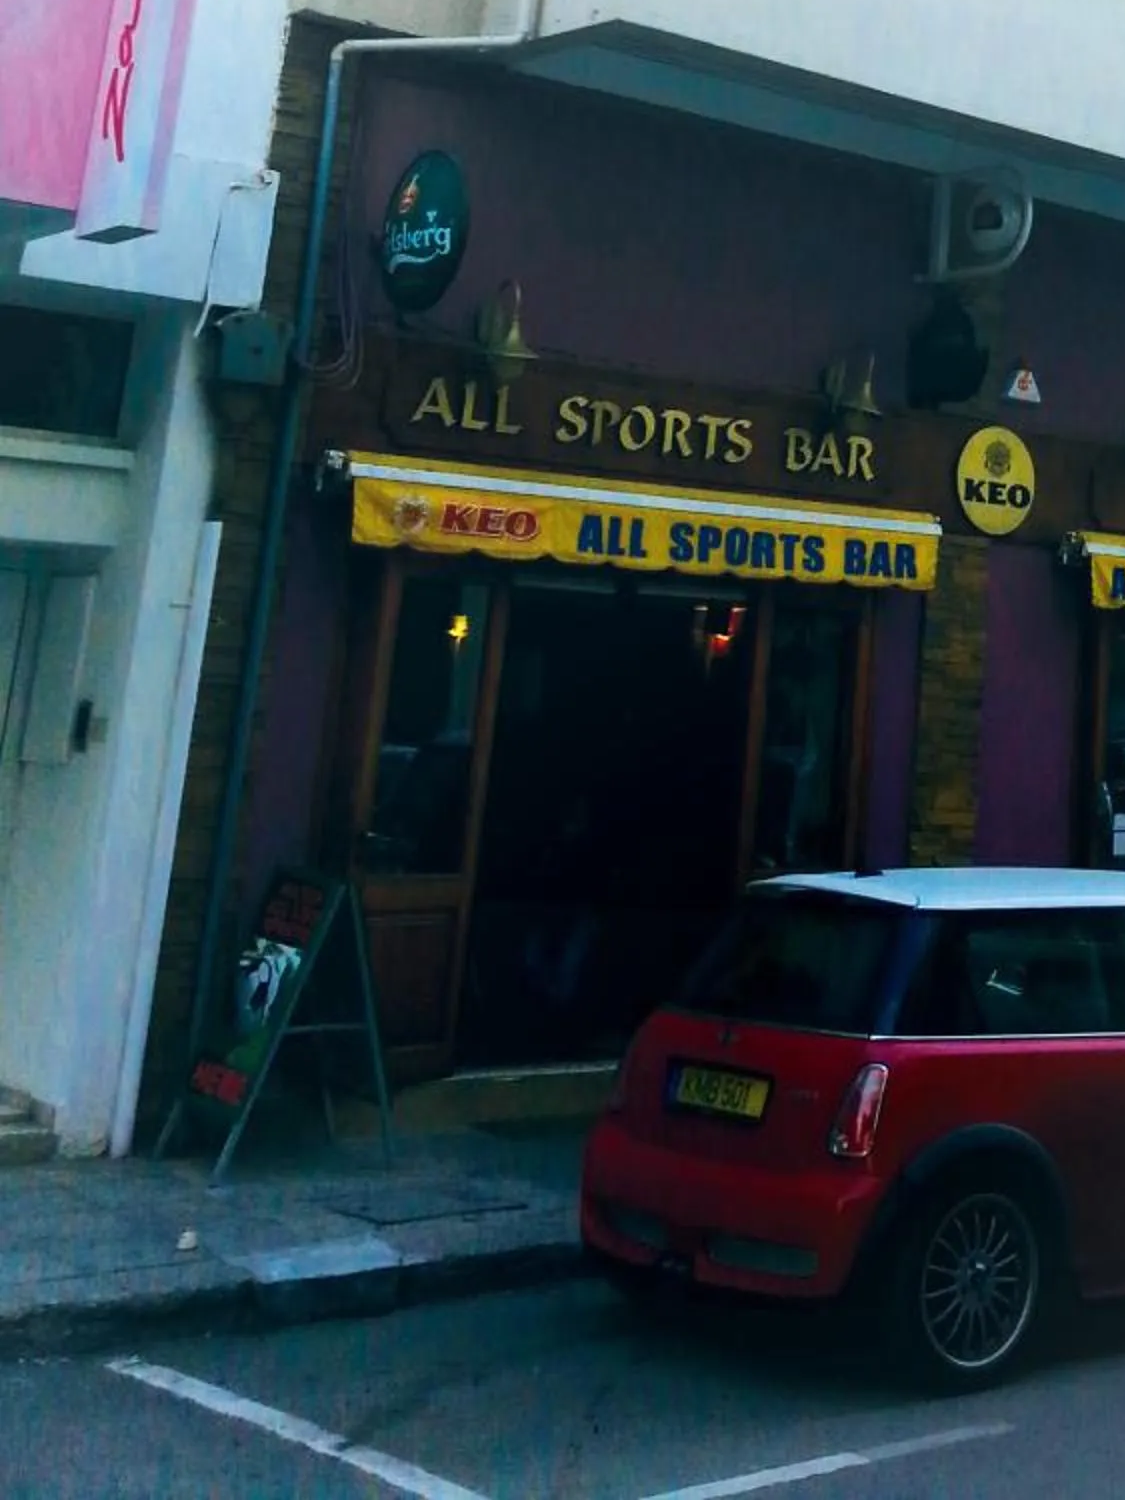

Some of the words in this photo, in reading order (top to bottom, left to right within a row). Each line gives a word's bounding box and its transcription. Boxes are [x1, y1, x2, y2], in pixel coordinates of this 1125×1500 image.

[411, 377, 522, 434] ALL
[555, 395, 753, 464] SPORTS
[783, 428, 876, 482] BAR
[964, 478, 1031, 508] KEO
[439, 503, 541, 542] KEO
[577, 514, 647, 559] ALL
[668, 522, 825, 574] SPORTS
[843, 539, 917, 580] BAR
